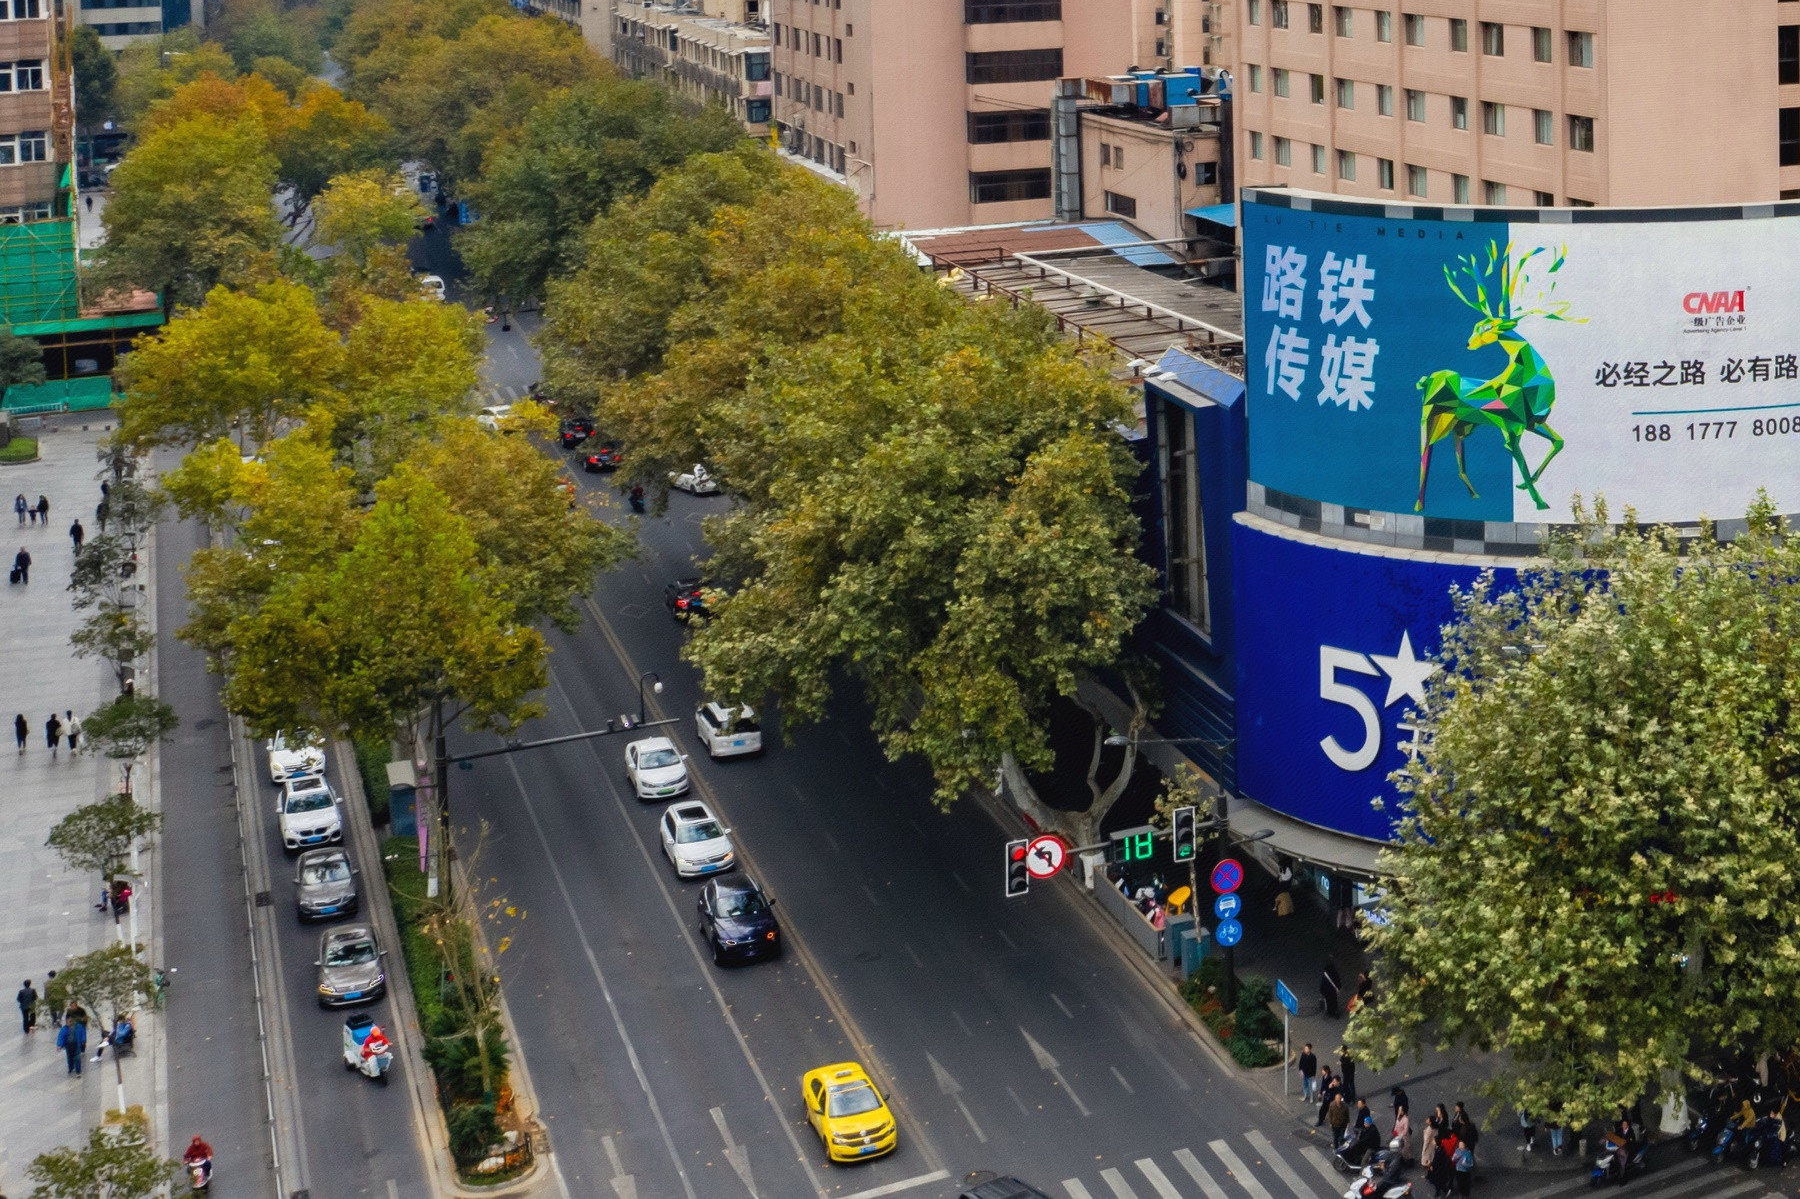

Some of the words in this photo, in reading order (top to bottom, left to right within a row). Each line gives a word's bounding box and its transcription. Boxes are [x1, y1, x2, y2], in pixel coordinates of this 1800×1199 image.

[1377, 227, 1464, 241] MEDIA
[1260, 244, 1376, 329] 路铁
[1688, 314, 1746, 326] 一级广告企业
[1264, 325, 1380, 413] 传媒
[1594, 359, 1707, 389] 必经之路
[1632, 424, 1671, 443] 188
[1686, 420, 1738, 441] 1777
